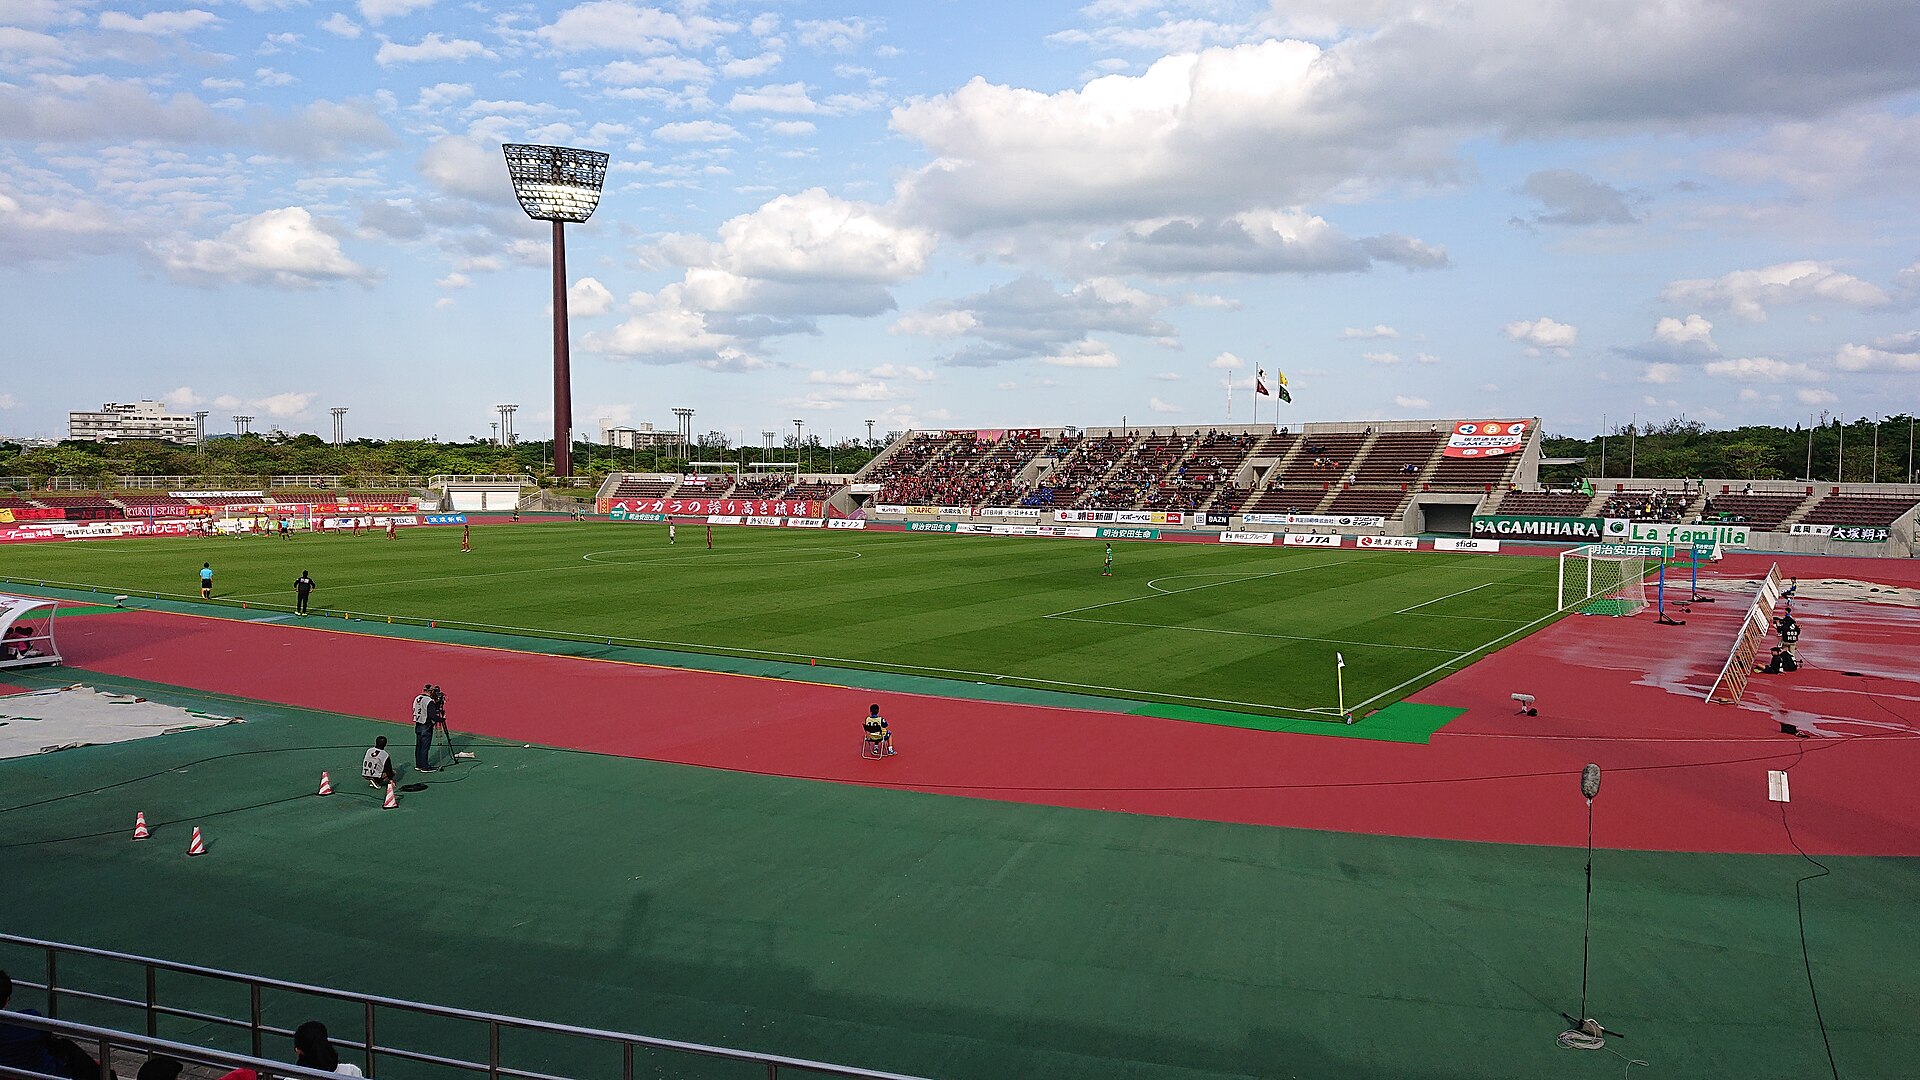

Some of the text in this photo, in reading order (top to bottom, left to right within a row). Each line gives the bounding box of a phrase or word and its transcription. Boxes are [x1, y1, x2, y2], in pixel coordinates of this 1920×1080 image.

[157, 505, 186, 516] SPIRIT
[614, 500, 807, 516] ベンガラの誇り高き琉球
[1076, 511, 1114, 521] 朝日新聞
[1120, 513, 1150, 521] スポーツくじ
[132, 523, 185, 534] オリオンビール
[911, 522, 952, 531] 明治安田生命
[1475, 520, 1600, 538] SAGAMIHARA
[1102, 529, 1152, 538] 明治安田生命
[1632, 525, 1745, 544] La familia
[1832, 526, 1887, 540] 大塚翔平
[1306, 536, 1330, 544] JTA
[1373, 538, 1414, 547] 琉球銀行
[1455, 540, 1478, 548] sfida
[1591, 545, 1664, 556] 明治安田生命
